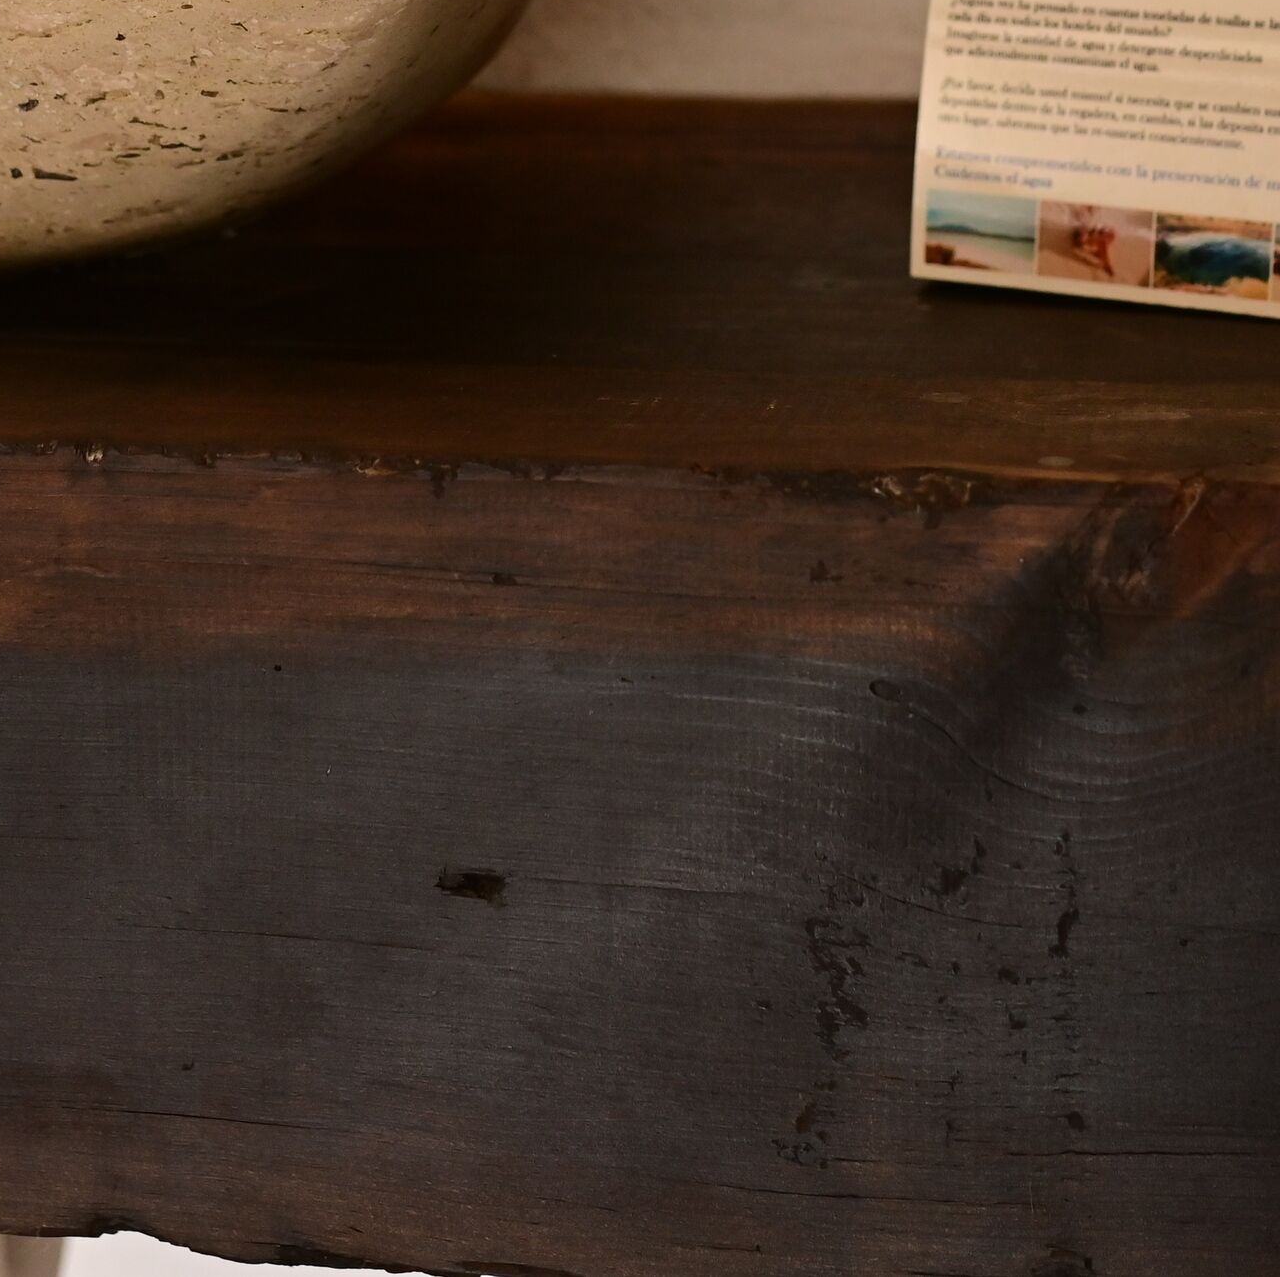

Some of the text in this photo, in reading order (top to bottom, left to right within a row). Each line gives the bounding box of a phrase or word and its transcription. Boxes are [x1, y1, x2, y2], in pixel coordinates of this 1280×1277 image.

[947, 9, 972, 22] cada
[994, 16, 1007, 24] en
[1011, 14, 1041, 27] todos
[1043, 16, 1059, 28] los
[1061, 18, 1101, 31] hoteles
[1104, 20, 1121, 33] del
[1033, 1, 1079, 15] pensado
[1082, 6, 1096, 14] en
[1143, 9, 1195, 21] toneladas
[1197, 11, 1211, 24] de
[1215, 13, 1250, 27] toallas
[1254, 19, 1265, 28] se
[944, 45, 962, 58] que
[1118, 56, 1129, 68] el
[1014, 32, 1061, 45] cantidad
[1064, 36, 1076, 48] de
[1081, 40, 1105, 52] agua
[1108, 43, 1114, 53] y
[1117, 41, 1175, 57] detergente
[1178, 45, 1263, 64] desperdiciados
[1040, 102, 1053, 114] de
[1056, 103, 1065, 115] la
[1122, 112, 1136, 121] en
[1199, 115, 1213, 128] las
[1216, 117, 1264, 134] deposita
[1267, 125, 1280, 134] en
[1173, 99, 1193, 112] que
[1198, 101, 1208, 110] se
[1212, 98, 1261, 114] cambien
[1263, 107, 1280, 117] sus
[1050, 123, 1069, 135] que
[933, 165, 1002, 182] Cuidemos
[1005, 170, 1018, 184] el
[1106, 164, 1131, 176] con
[1136, 164, 1148, 177] la
[1152, 167, 1240, 188] preservación
[1244, 174, 1261, 188] de
